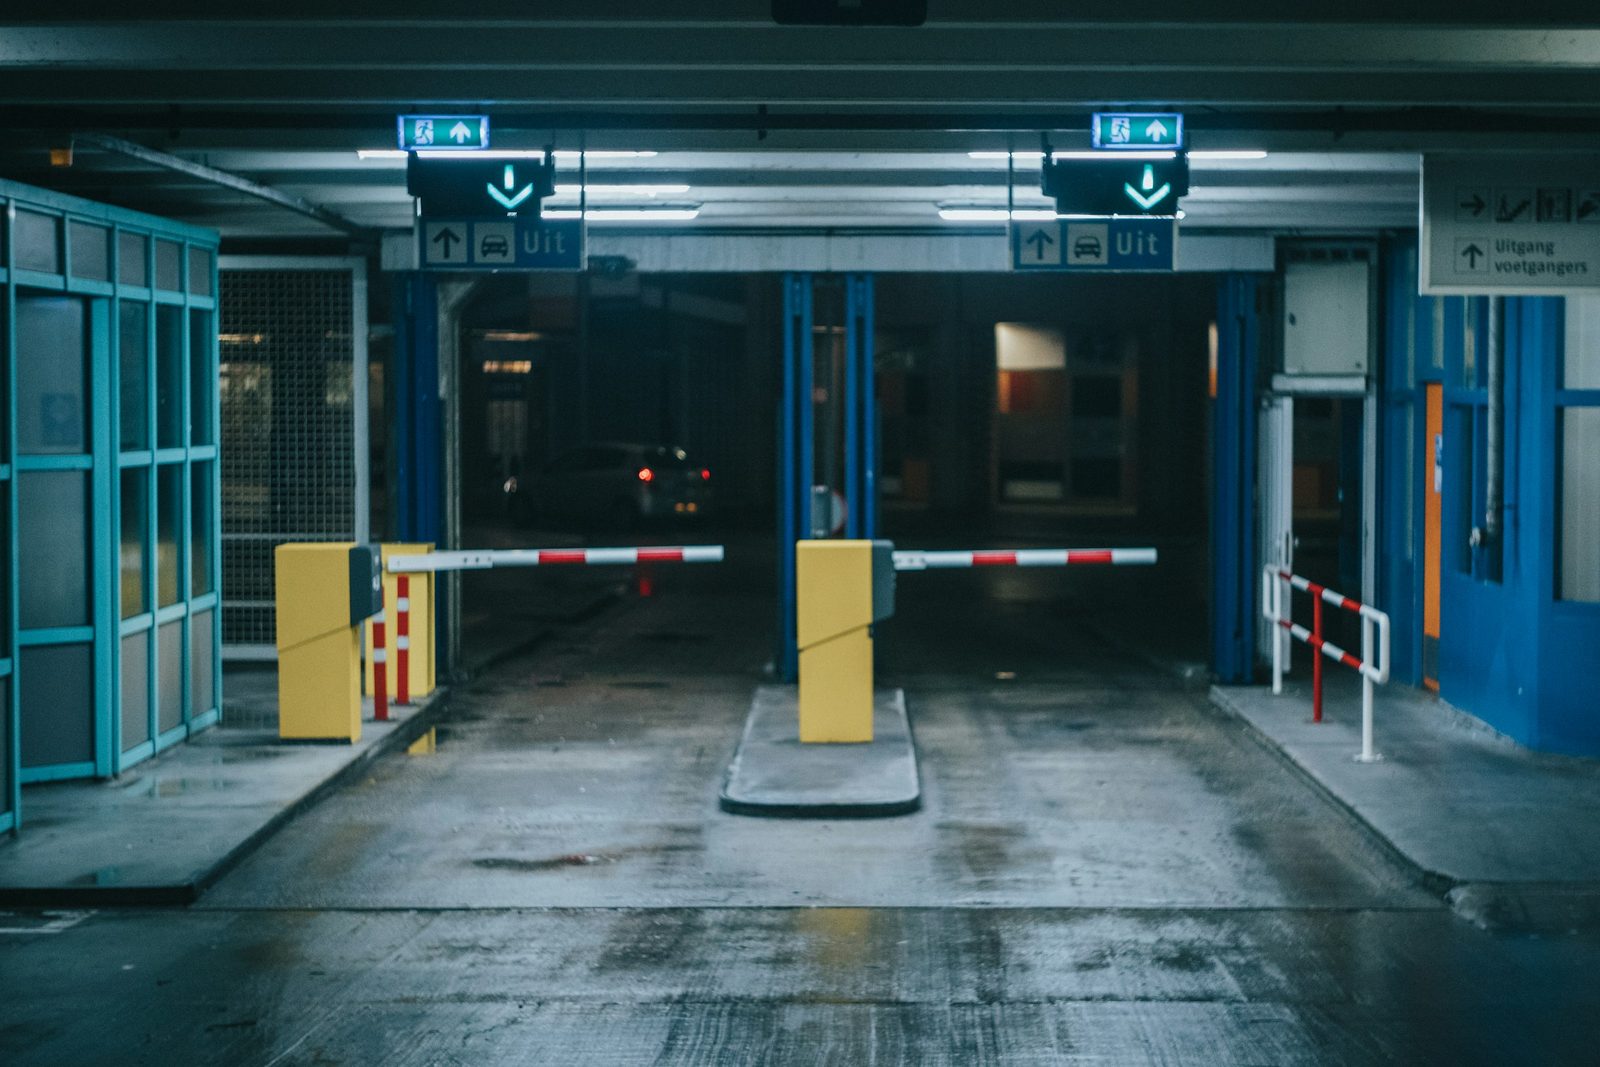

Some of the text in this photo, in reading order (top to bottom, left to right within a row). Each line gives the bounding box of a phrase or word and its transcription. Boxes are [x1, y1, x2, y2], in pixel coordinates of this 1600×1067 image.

[524, 229, 566, 254] Uit
[1117, 230, 1159, 255] Uit
[1495, 239, 1554, 256] Uitgang
[1495, 261, 1587, 276] voetgangers
